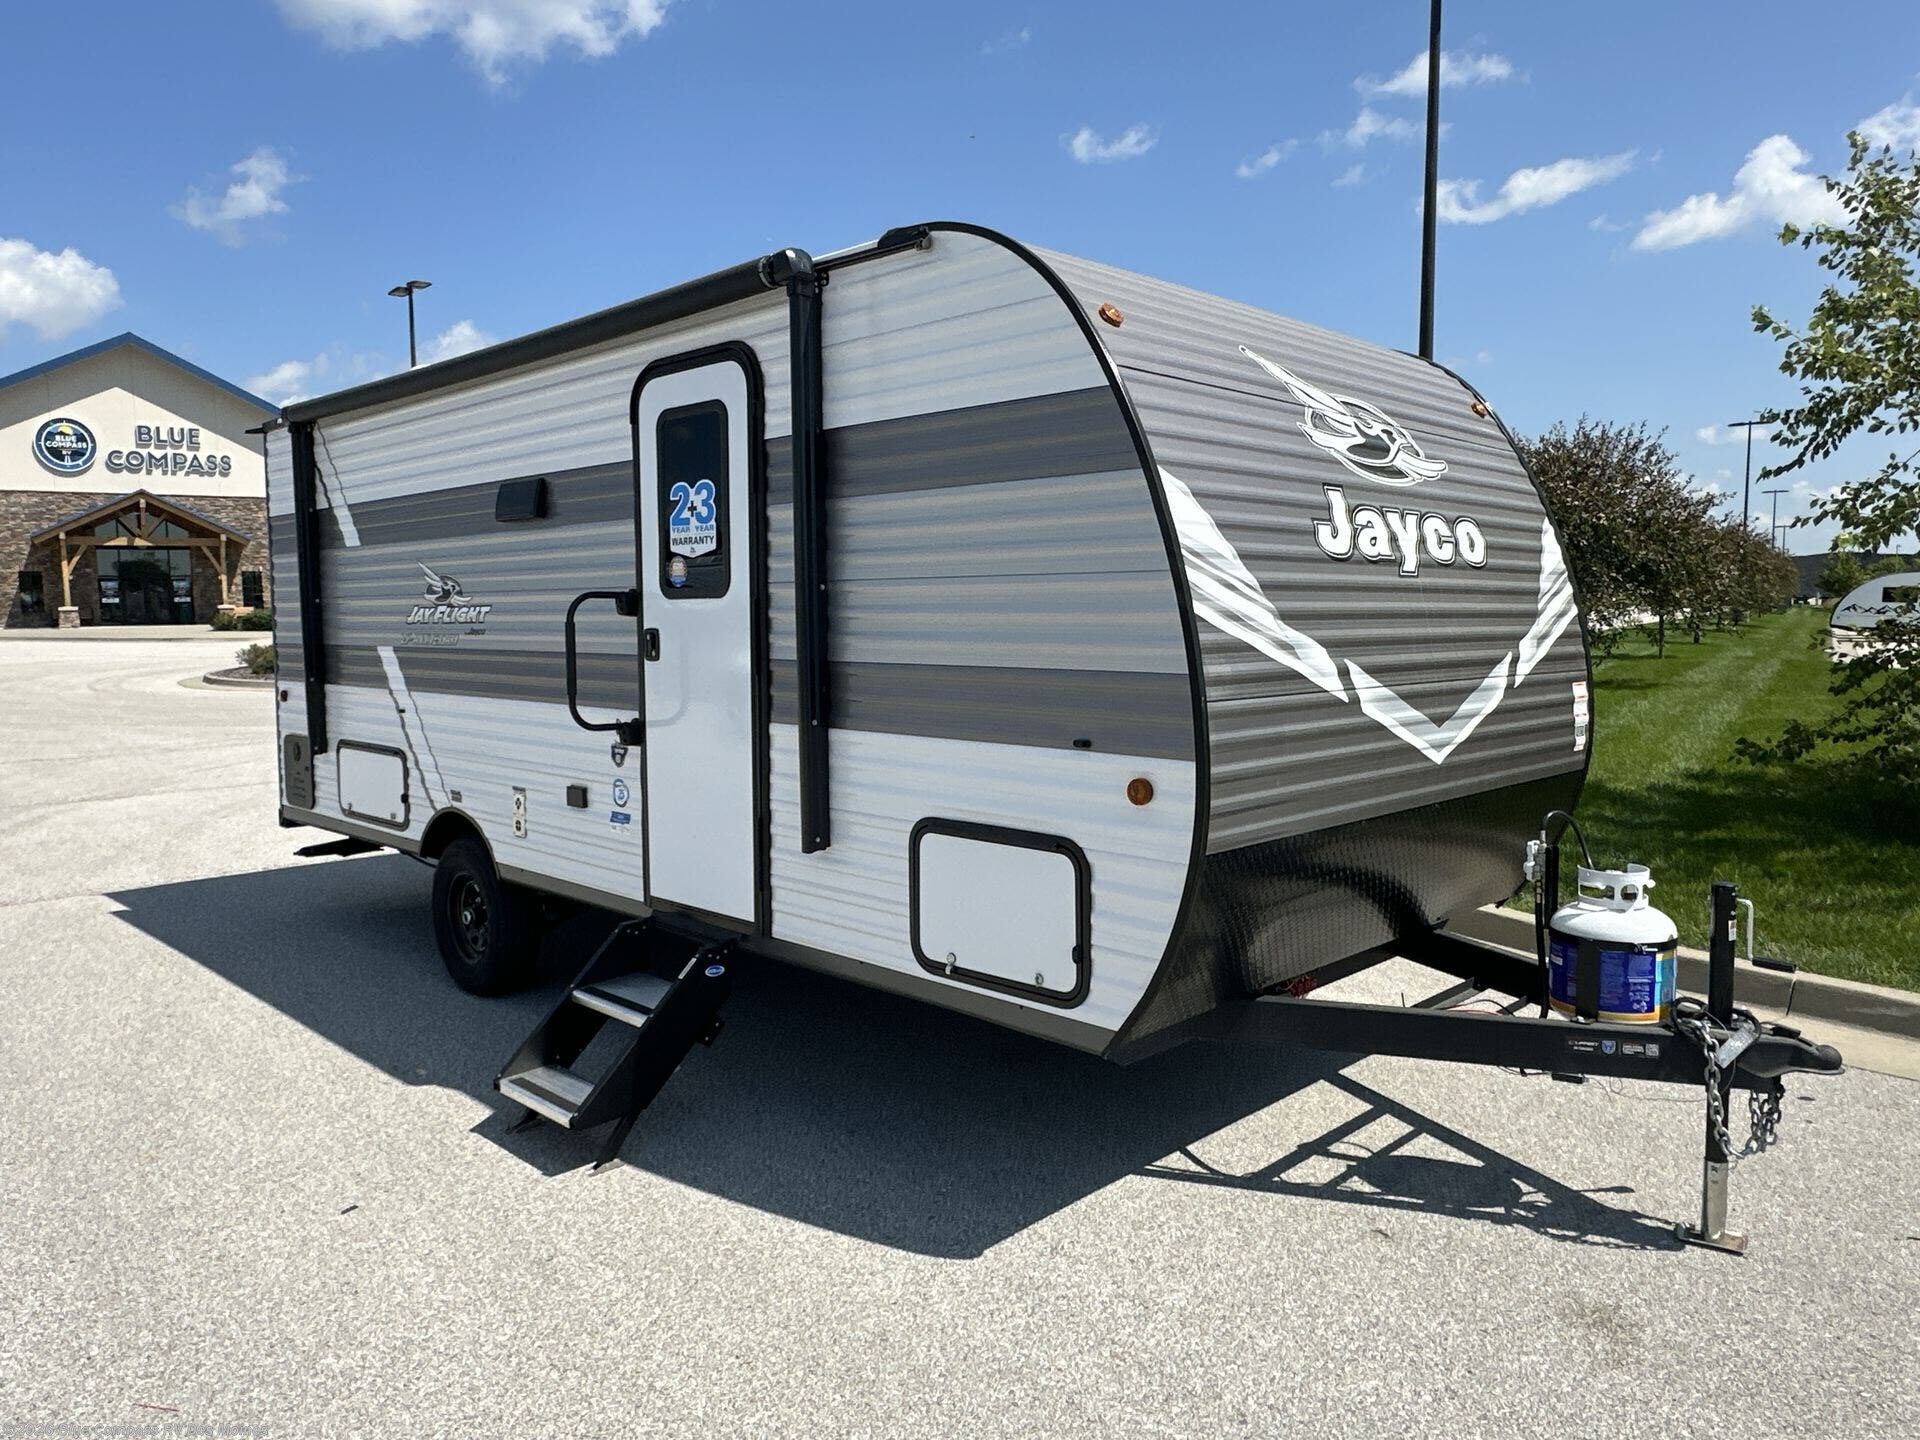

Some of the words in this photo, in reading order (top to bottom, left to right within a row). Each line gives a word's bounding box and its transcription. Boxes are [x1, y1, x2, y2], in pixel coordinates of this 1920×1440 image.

[55, 434, 77, 442] BLUE
[135, 425, 201, 446] BLUE
[45, 440, 88, 449] COMPASS
[106, 450, 232, 473] COMPASS
[671, 525, 691, 534] YEAR
[695, 523, 715, 533] YEAR
[1311, 482, 1488, 578] Jayco
[671, 535, 715, 547] WARRANTY
[406, 605, 435, 625] JAY
[433, 604, 492, 624] FLIGHT
